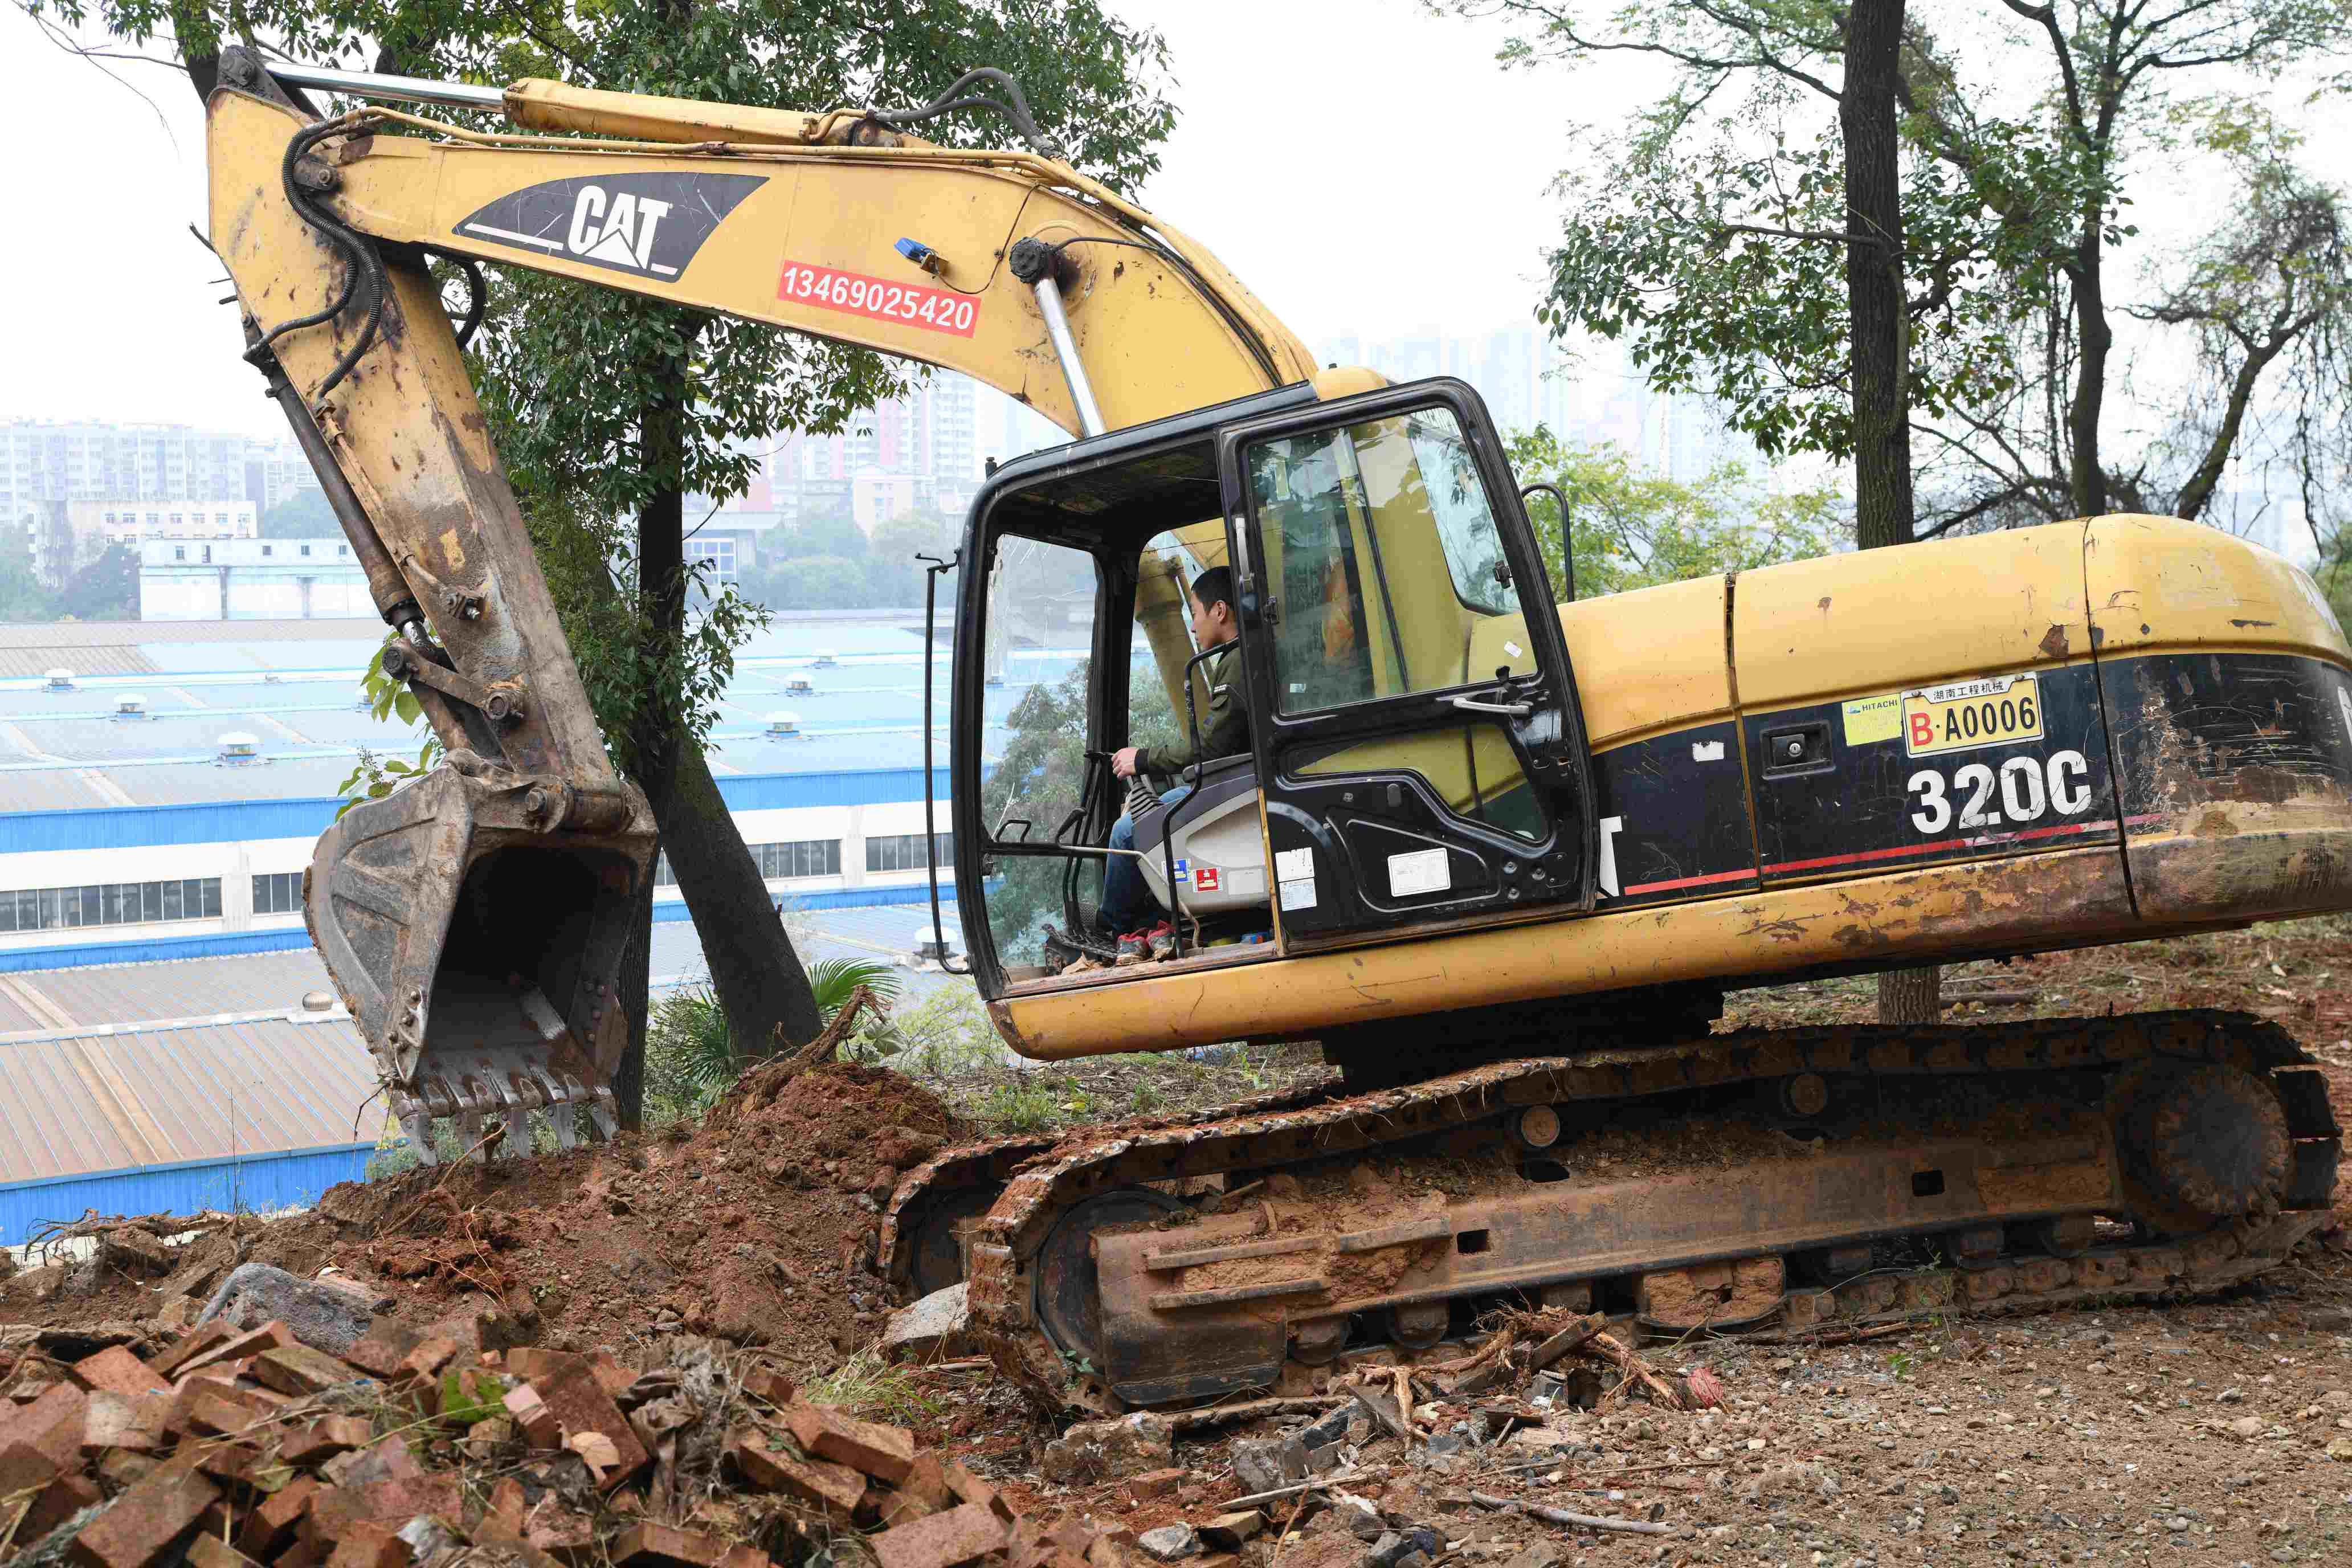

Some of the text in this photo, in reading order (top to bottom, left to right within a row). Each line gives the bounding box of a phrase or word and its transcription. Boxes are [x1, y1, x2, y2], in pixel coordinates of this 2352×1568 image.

[567, 185, 670, 269] CAT
[784, 267, 974, 329] 13469025420
[1862, 700, 1897, 711] HITACHI
[1933, 681, 2004, 701] 湖南工程机械
[1907, 749, 2092, 834] 320C
